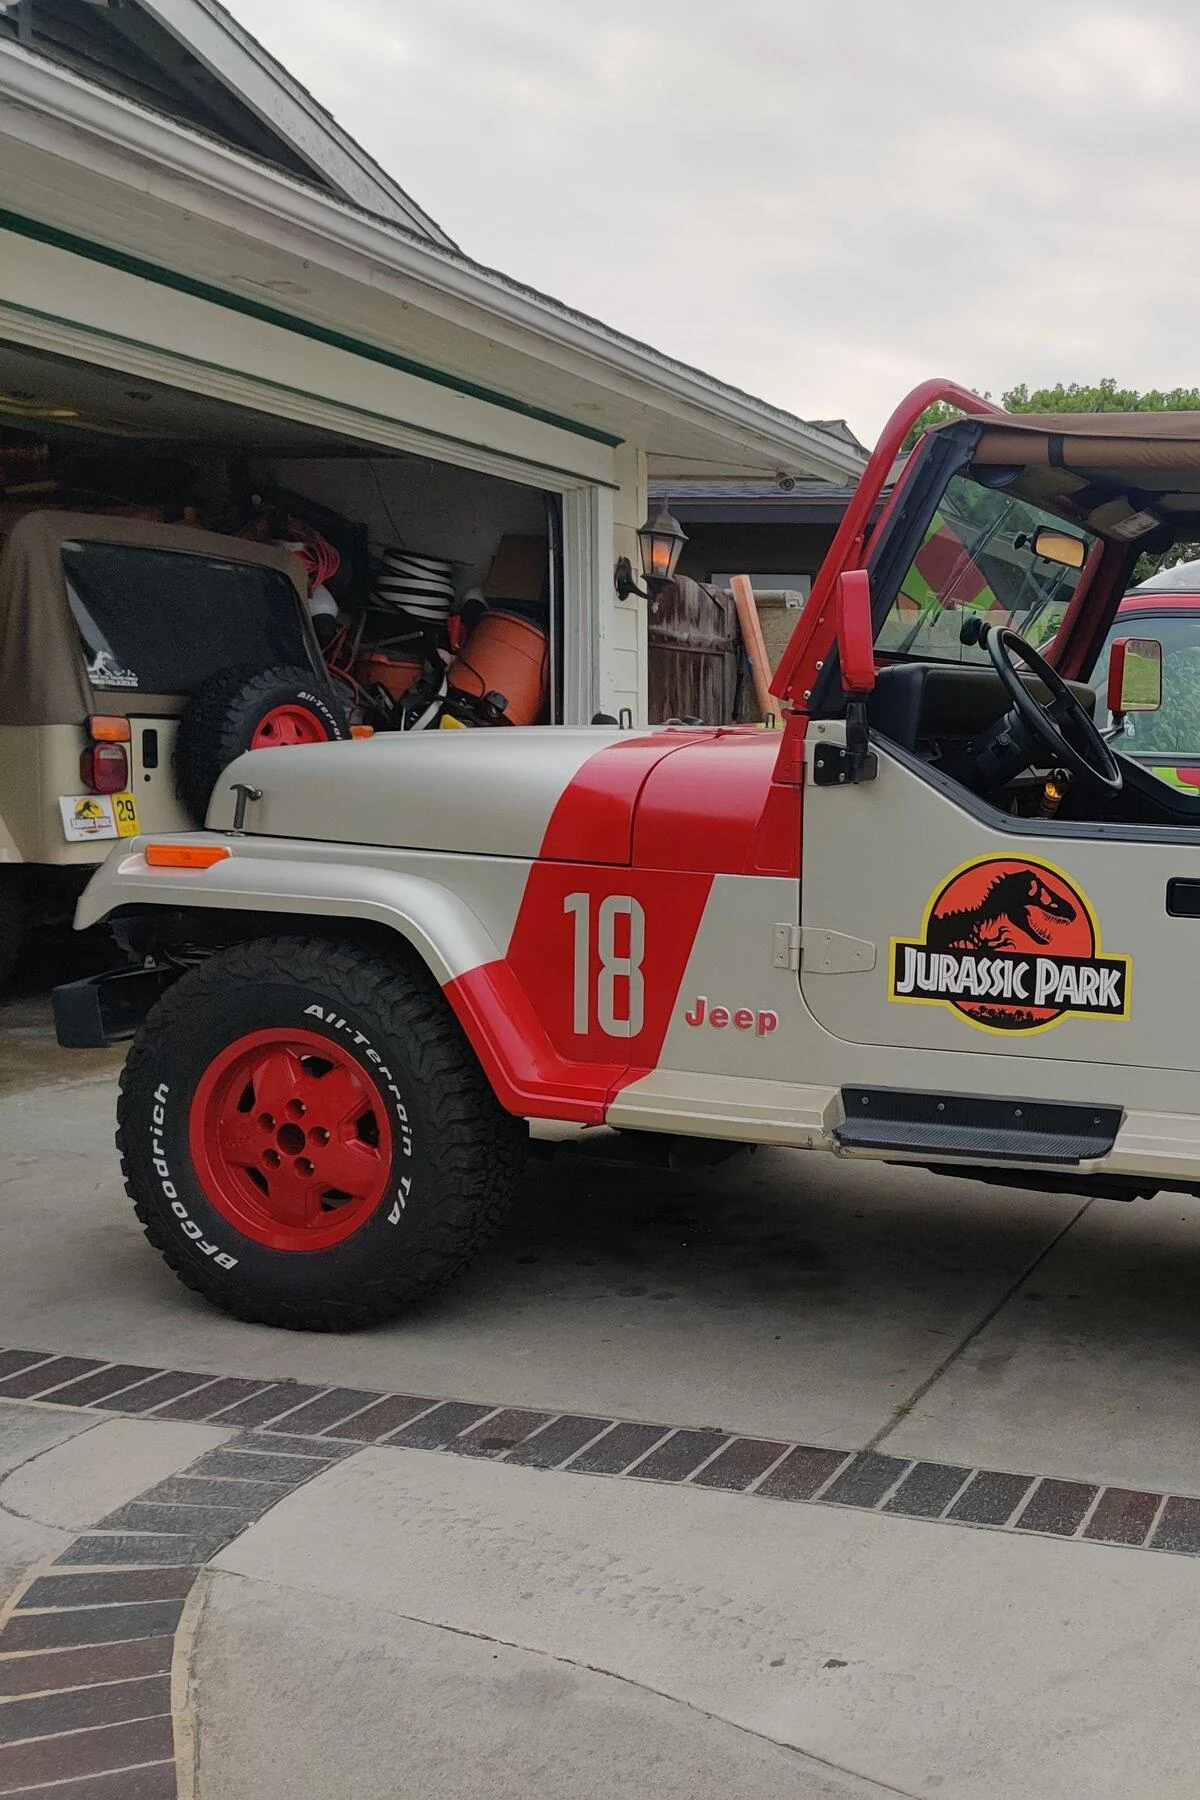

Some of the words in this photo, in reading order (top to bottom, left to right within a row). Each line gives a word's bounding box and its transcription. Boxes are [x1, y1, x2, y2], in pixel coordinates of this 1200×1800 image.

[117, 800, 135, 822] 29
[563, 892, 646, 1038] 18
[684, 995, 779, 1038] Jeep
[896, 946, 1031, 1000] JURASSIC
[1034, 957, 1122, 1008] PARK
[303, 1003, 414, 1157] All-Terrain
[387, 1175, 413, 1226] T/A
[149, 1082, 239, 1271] BFGoodrich
